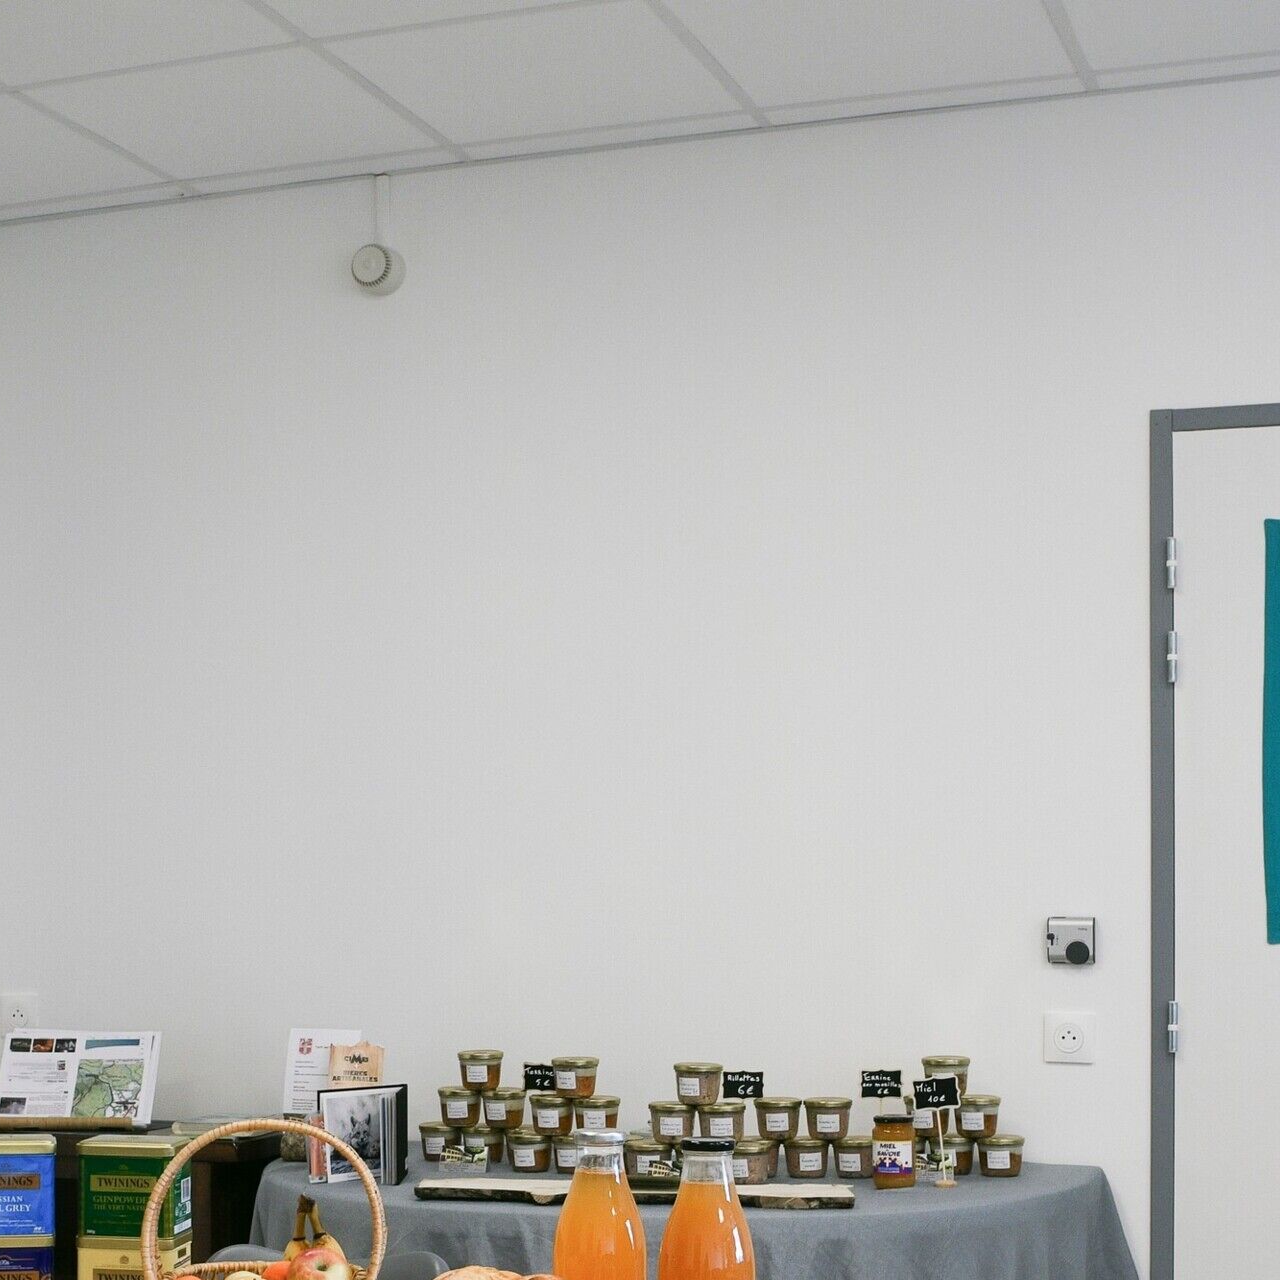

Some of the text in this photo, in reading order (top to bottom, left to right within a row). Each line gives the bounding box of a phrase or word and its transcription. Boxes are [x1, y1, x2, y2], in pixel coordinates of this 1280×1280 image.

[915, 1081, 936, 1093] Miel
[97, 1177, 150, 1188] TWININGS
[5, 1204, 31, 1212] GREY
